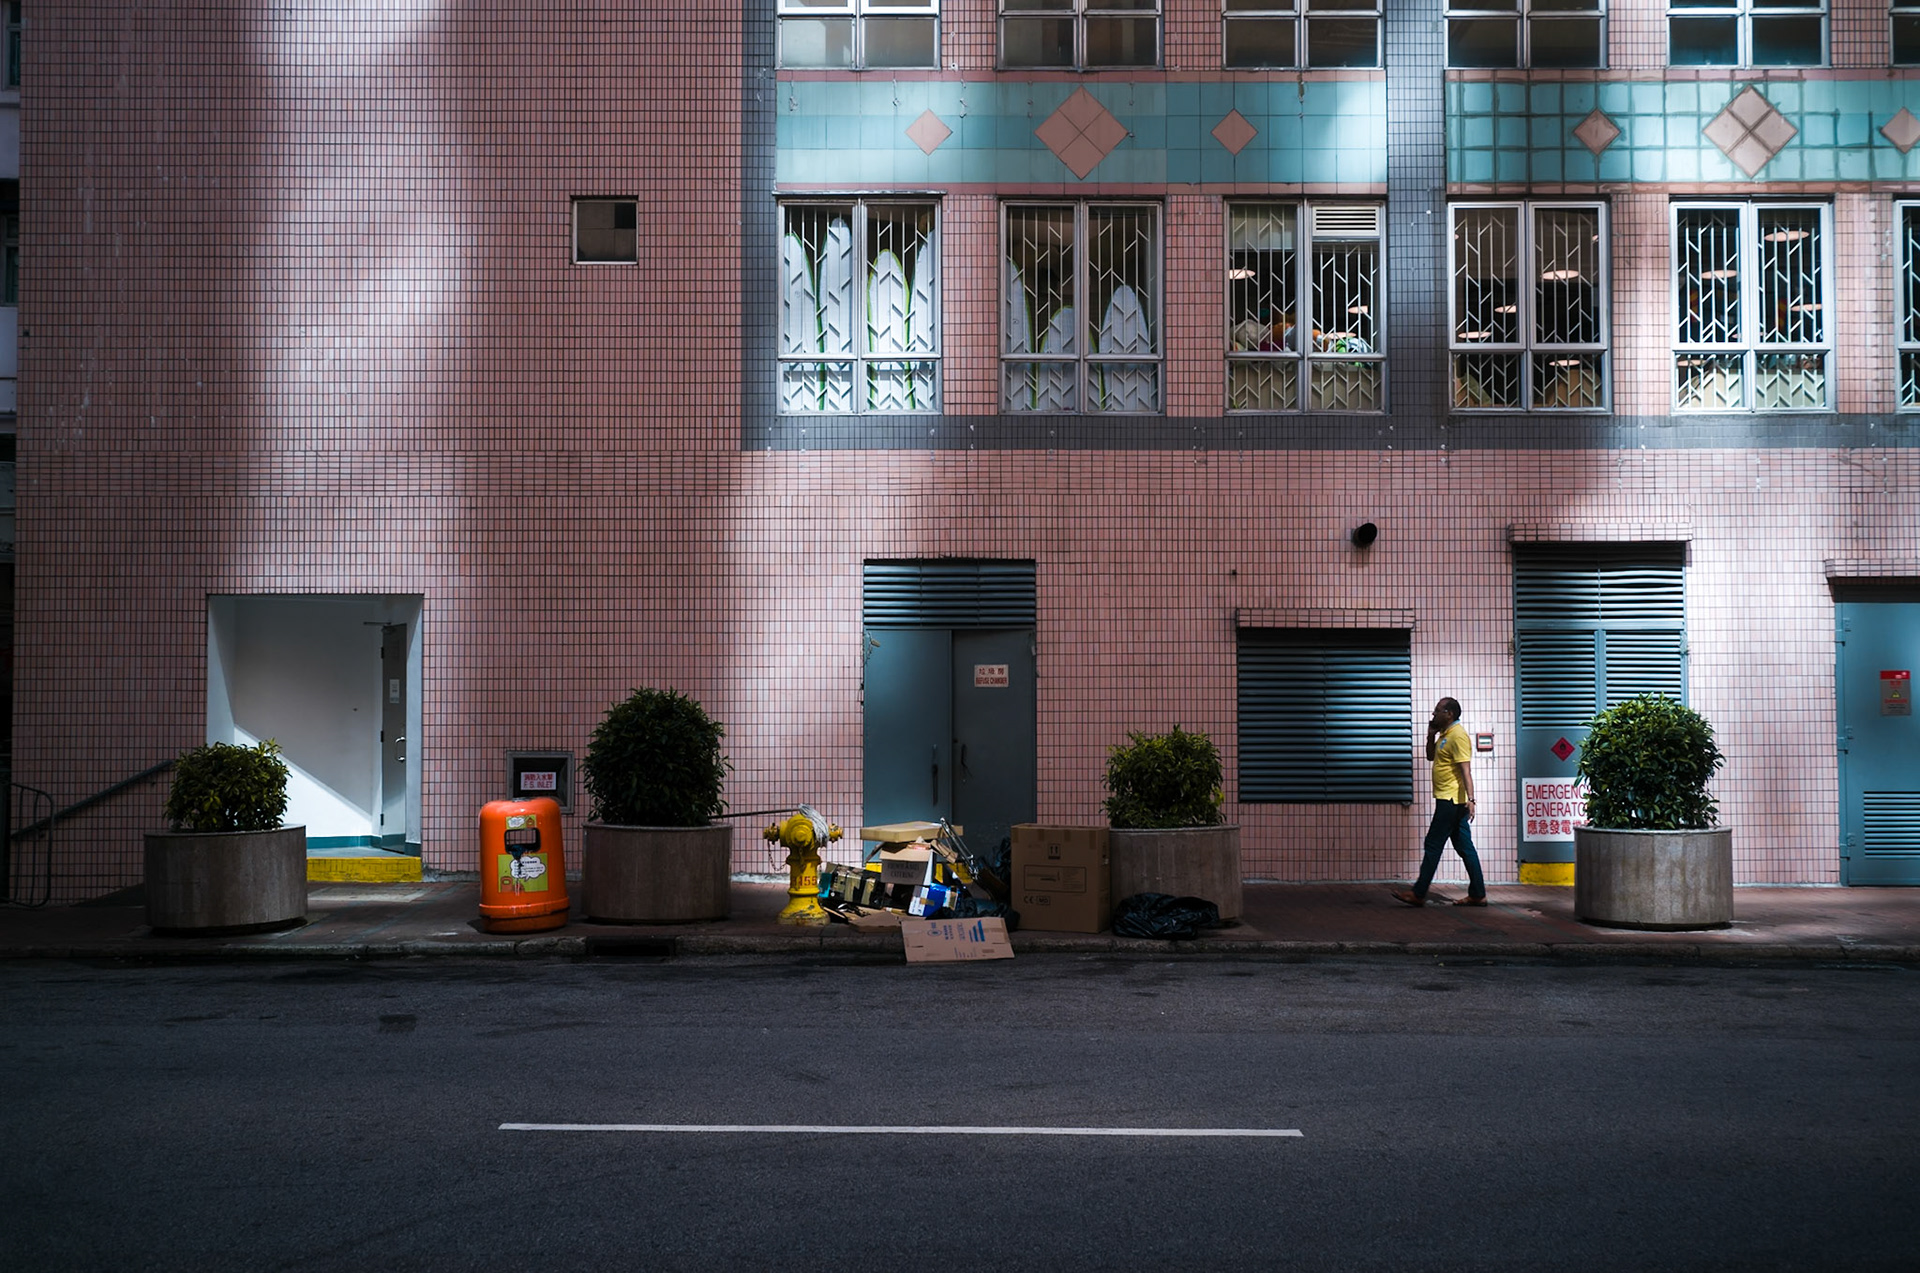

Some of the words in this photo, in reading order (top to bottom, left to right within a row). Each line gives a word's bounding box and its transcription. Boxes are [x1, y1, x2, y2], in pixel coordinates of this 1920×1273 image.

[1526, 802, 1588, 817] GENERATO
[1527, 820, 1591, 835] 應急發電
